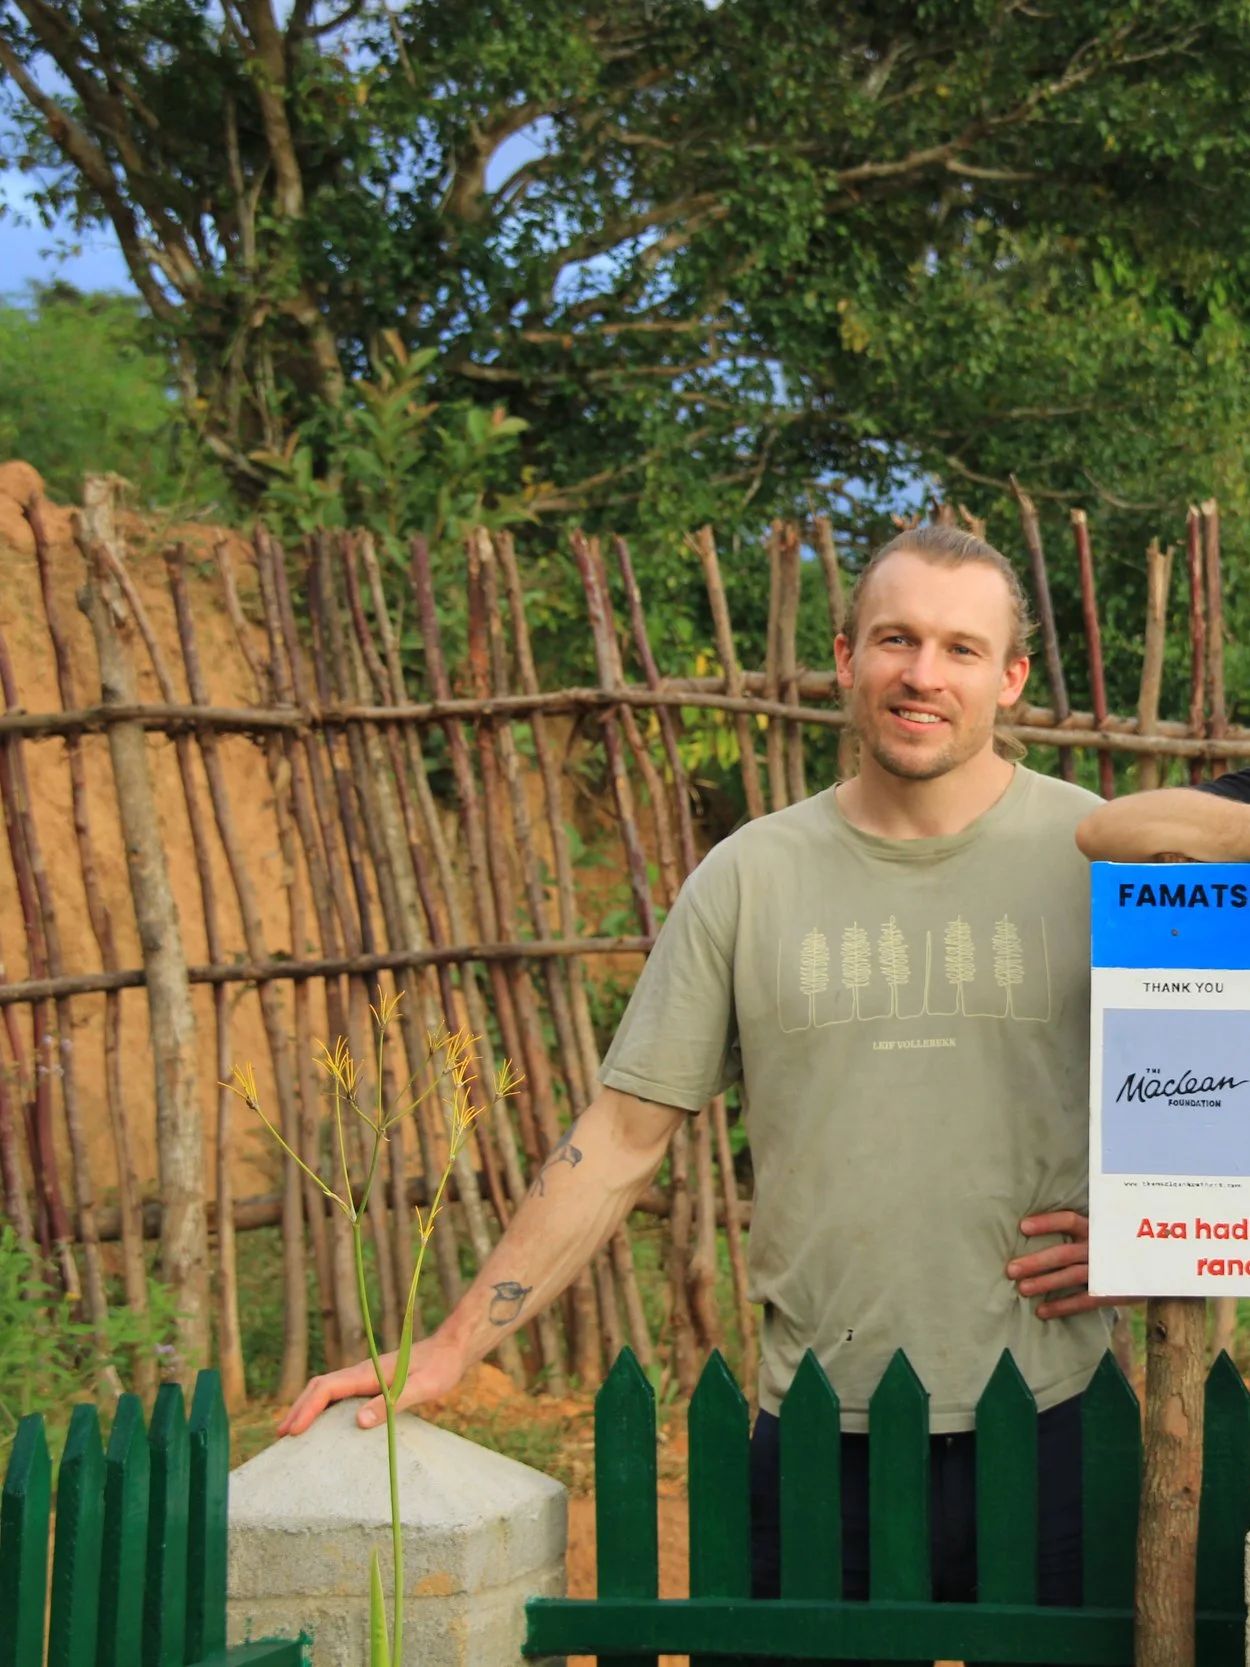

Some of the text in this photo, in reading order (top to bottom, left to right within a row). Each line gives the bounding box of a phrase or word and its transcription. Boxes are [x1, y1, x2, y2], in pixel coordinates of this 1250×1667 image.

[1143, 982, 1224, 993] THANK YOU
[1115, 1069, 1250, 1102] Maclean
[1168, 1099, 1221, 1107] FOUNDATION
[1136, 1218, 1187, 1239] Aza
